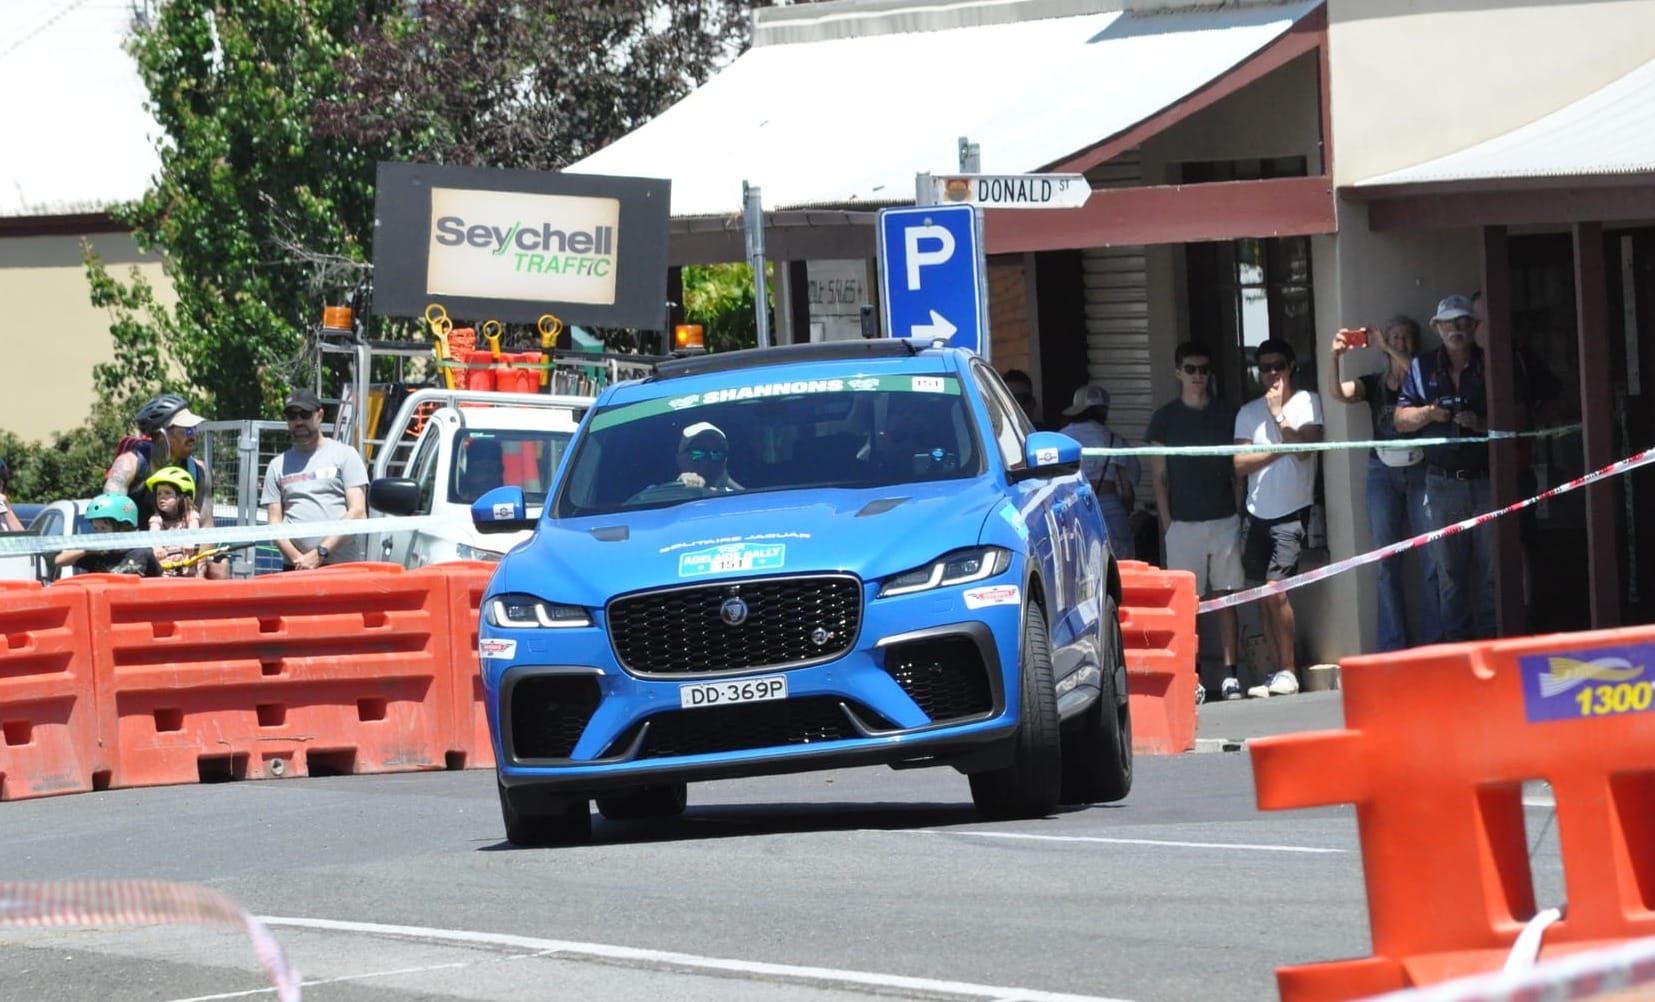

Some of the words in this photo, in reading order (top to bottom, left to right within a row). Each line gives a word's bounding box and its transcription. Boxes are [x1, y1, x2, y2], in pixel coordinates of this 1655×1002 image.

[978, 179, 1052, 203] DONALD
[1058, 179, 1070, 191] ST
[435, 216, 613, 256] Seychell
[514, 253, 612, 277] TRAFFIC
[904, 225, 956, 291] P
[702, 379, 844, 404] SHANNONS
[744, 531, 811, 541] JAGUAR
[720, 558, 743, 570] 151
